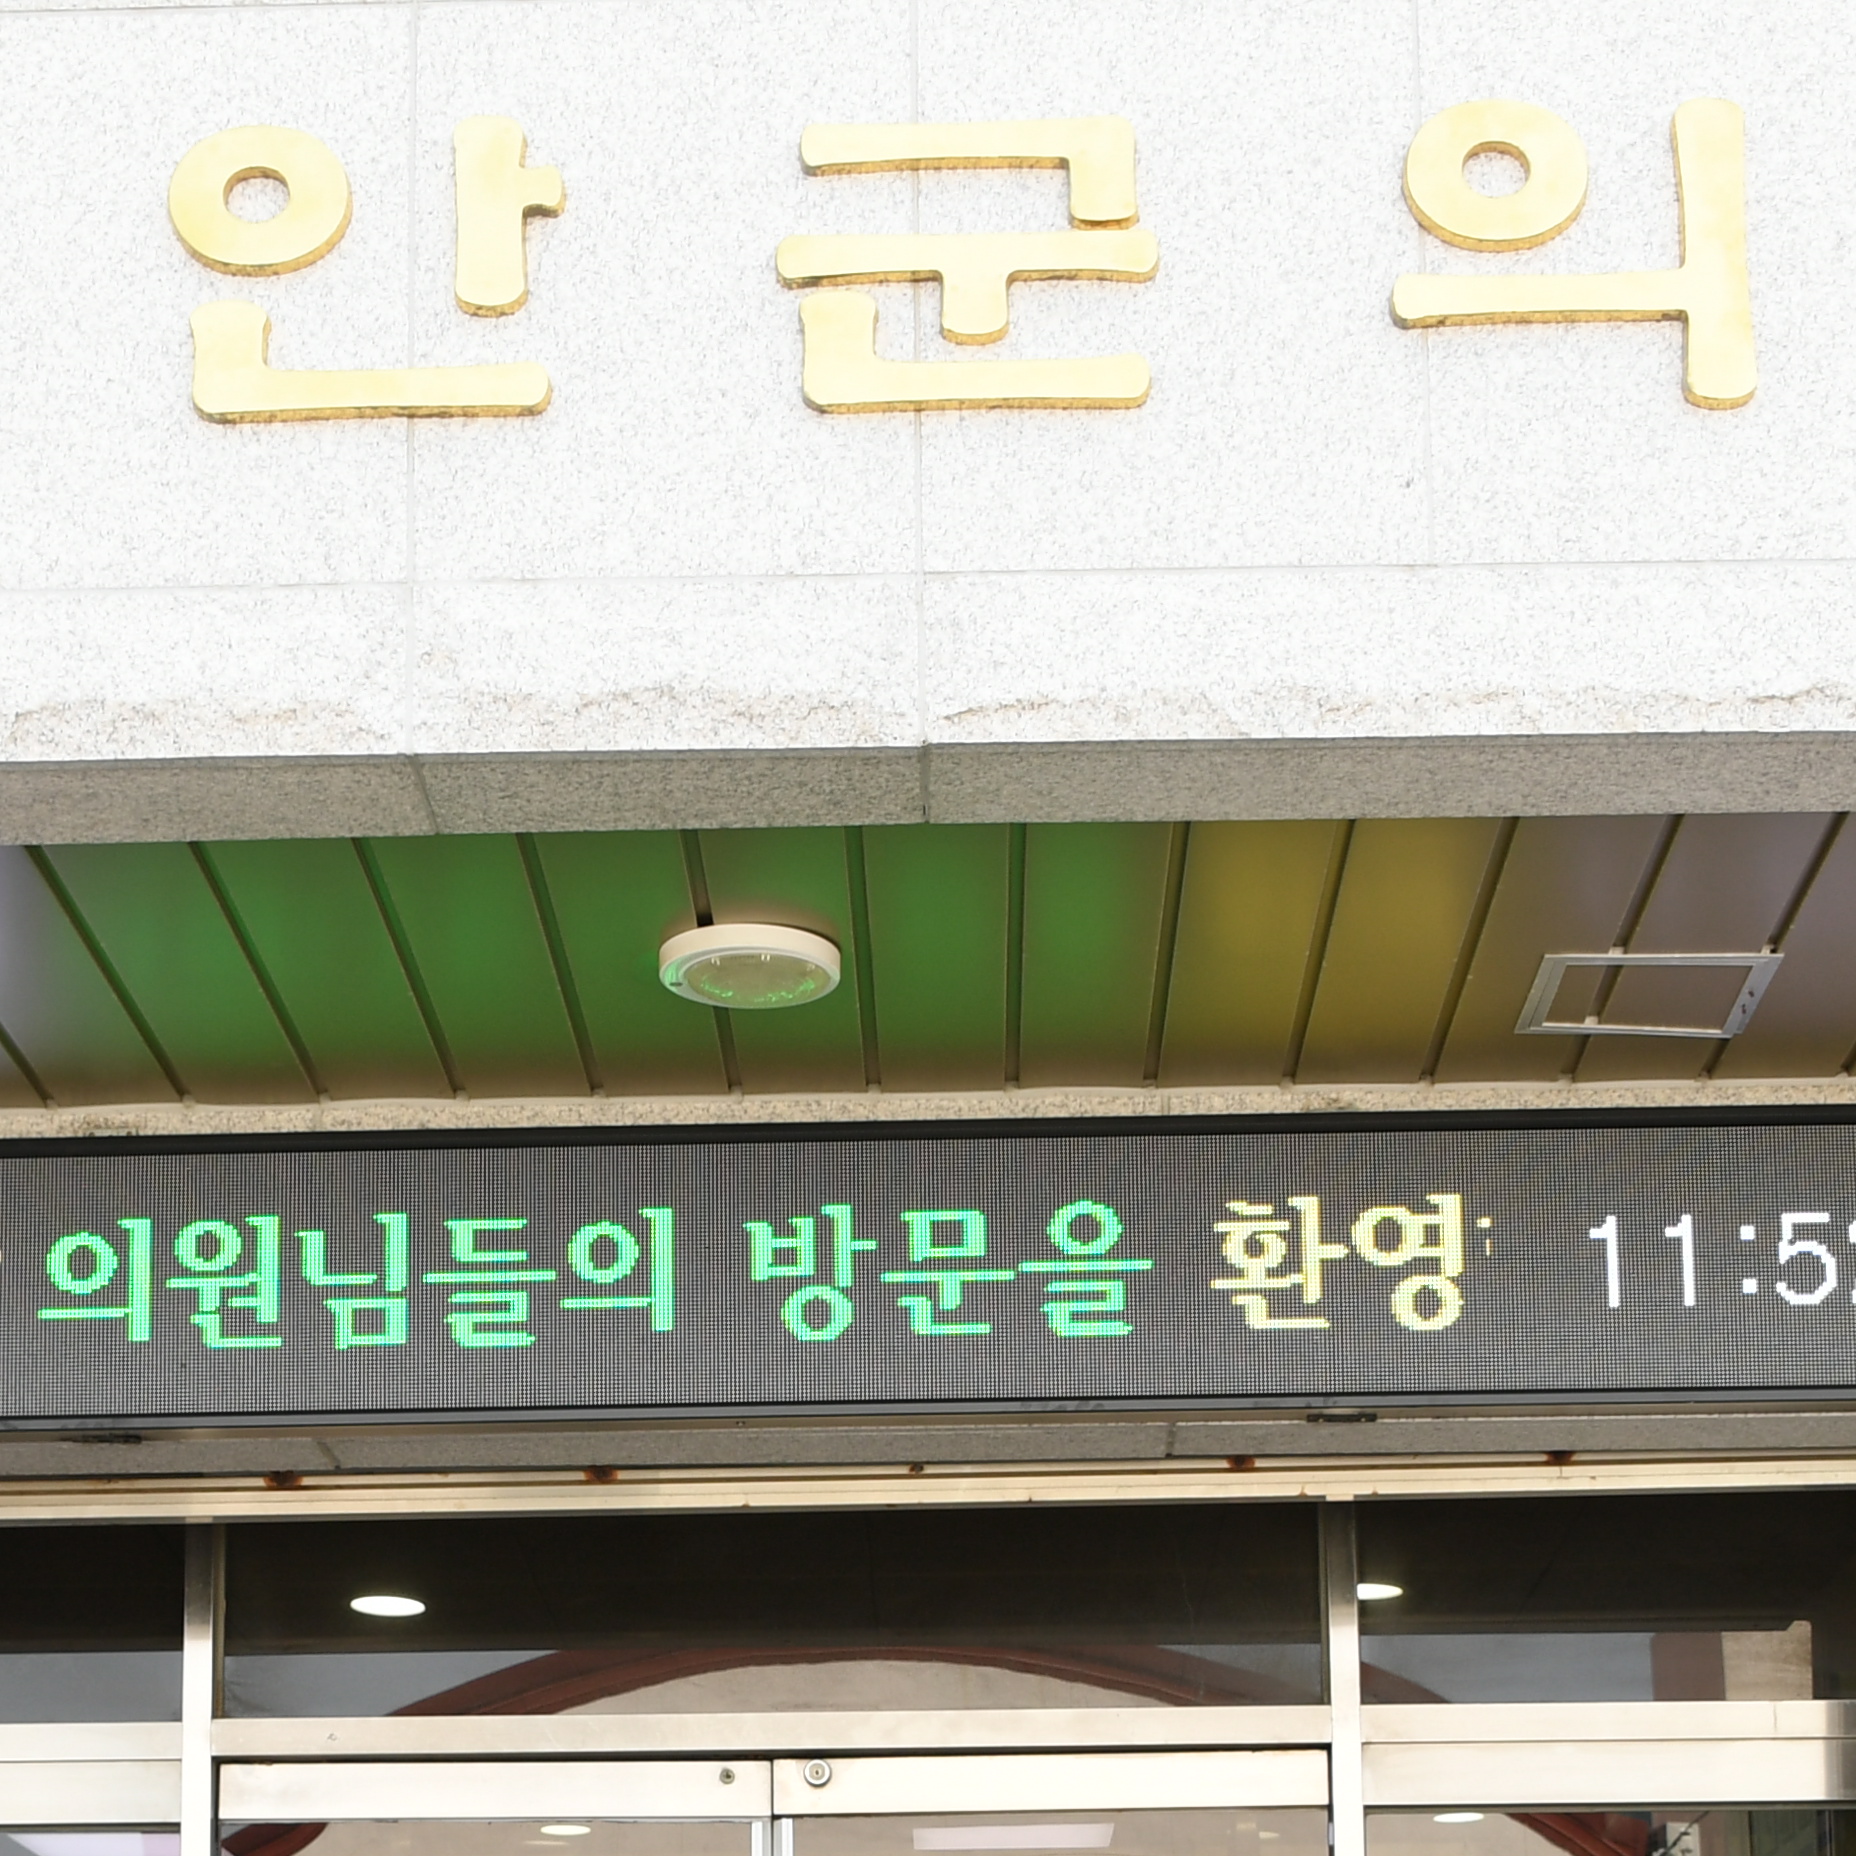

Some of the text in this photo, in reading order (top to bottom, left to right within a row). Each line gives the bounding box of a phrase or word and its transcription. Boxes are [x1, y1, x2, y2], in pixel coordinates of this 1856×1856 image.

[37, 1193, 1492, 1349] 의원님들의 방문을 환영
